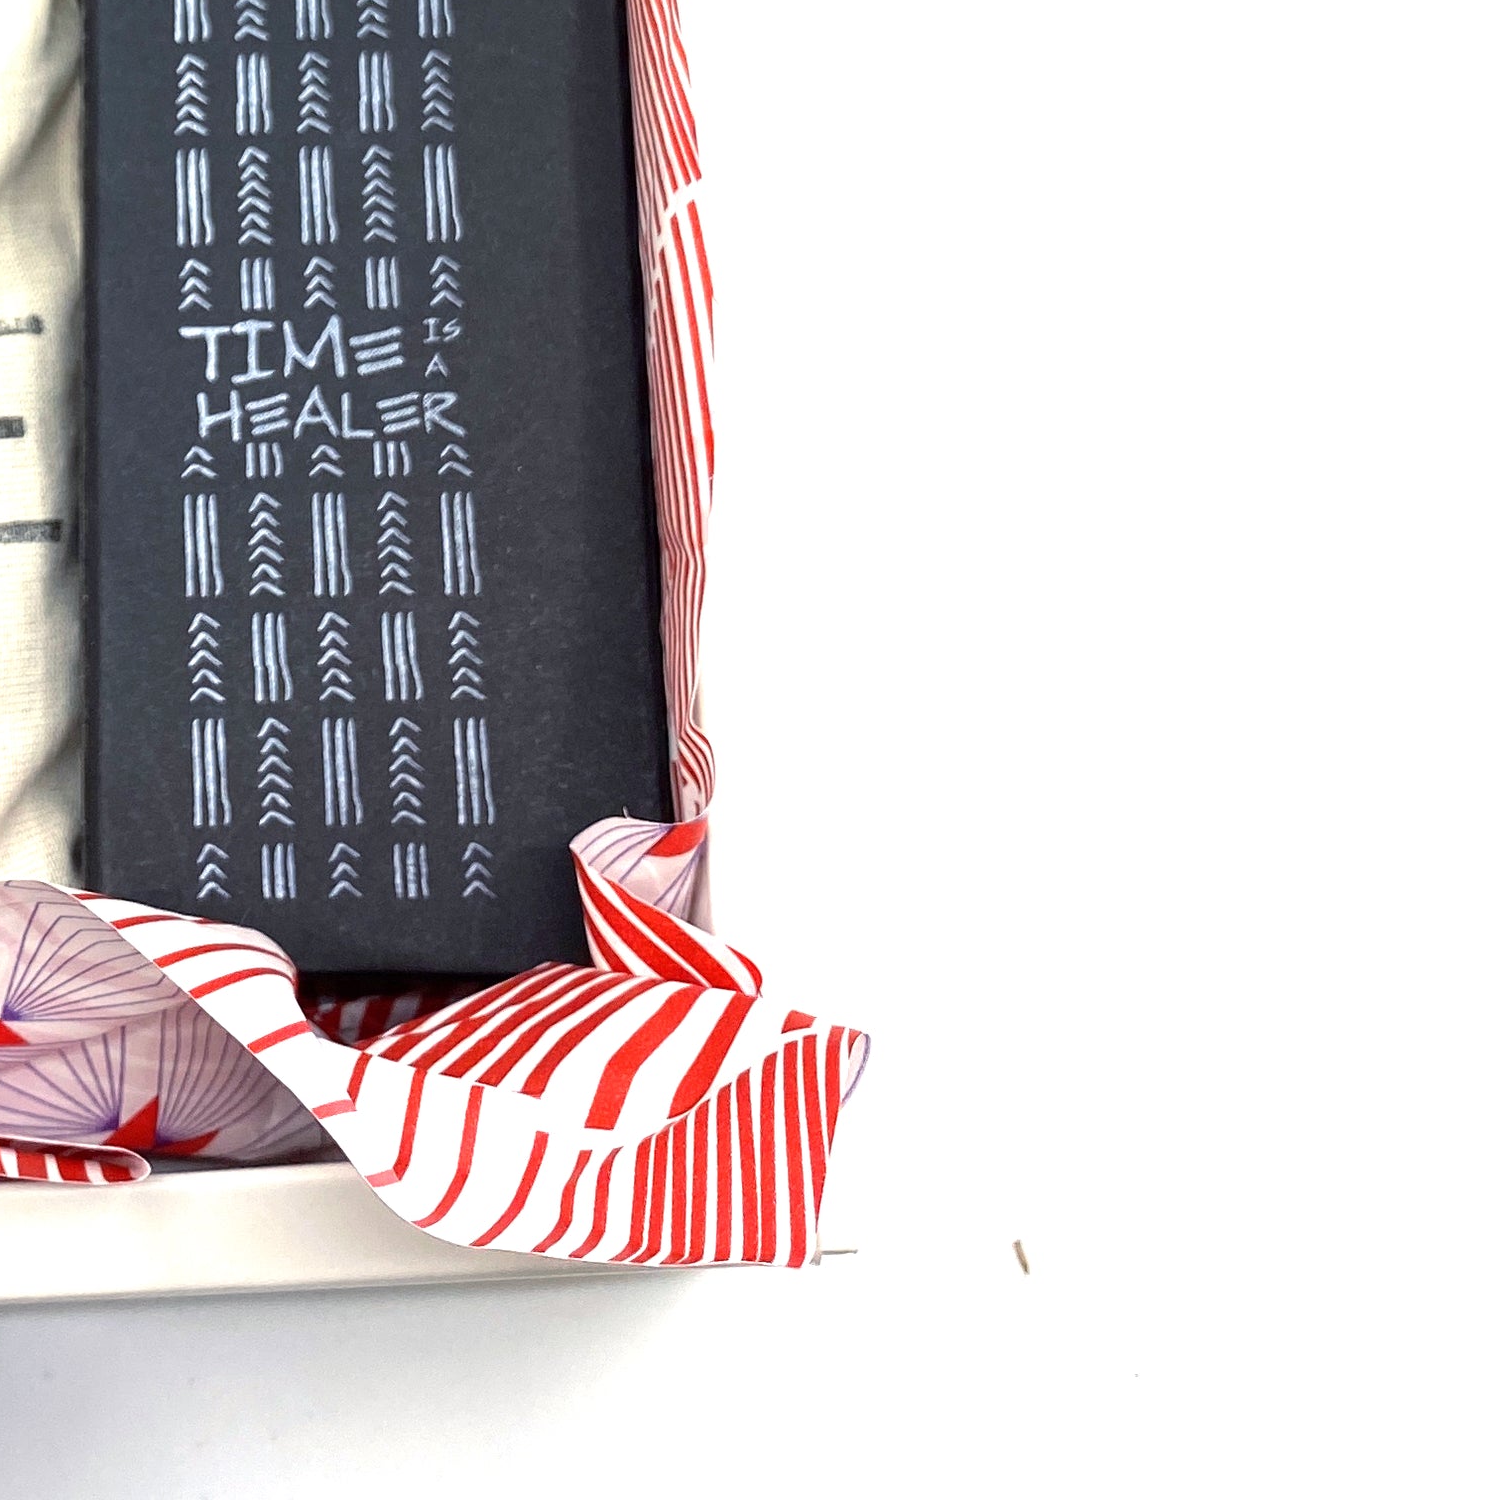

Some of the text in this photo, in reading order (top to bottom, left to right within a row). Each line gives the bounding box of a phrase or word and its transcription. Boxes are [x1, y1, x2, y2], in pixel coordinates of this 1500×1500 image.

[178, 313, 405, 385] TIME
[422, 316, 463, 345] IS
[424, 352, 450, 379] A
[195, 383, 468, 443] HEALER
